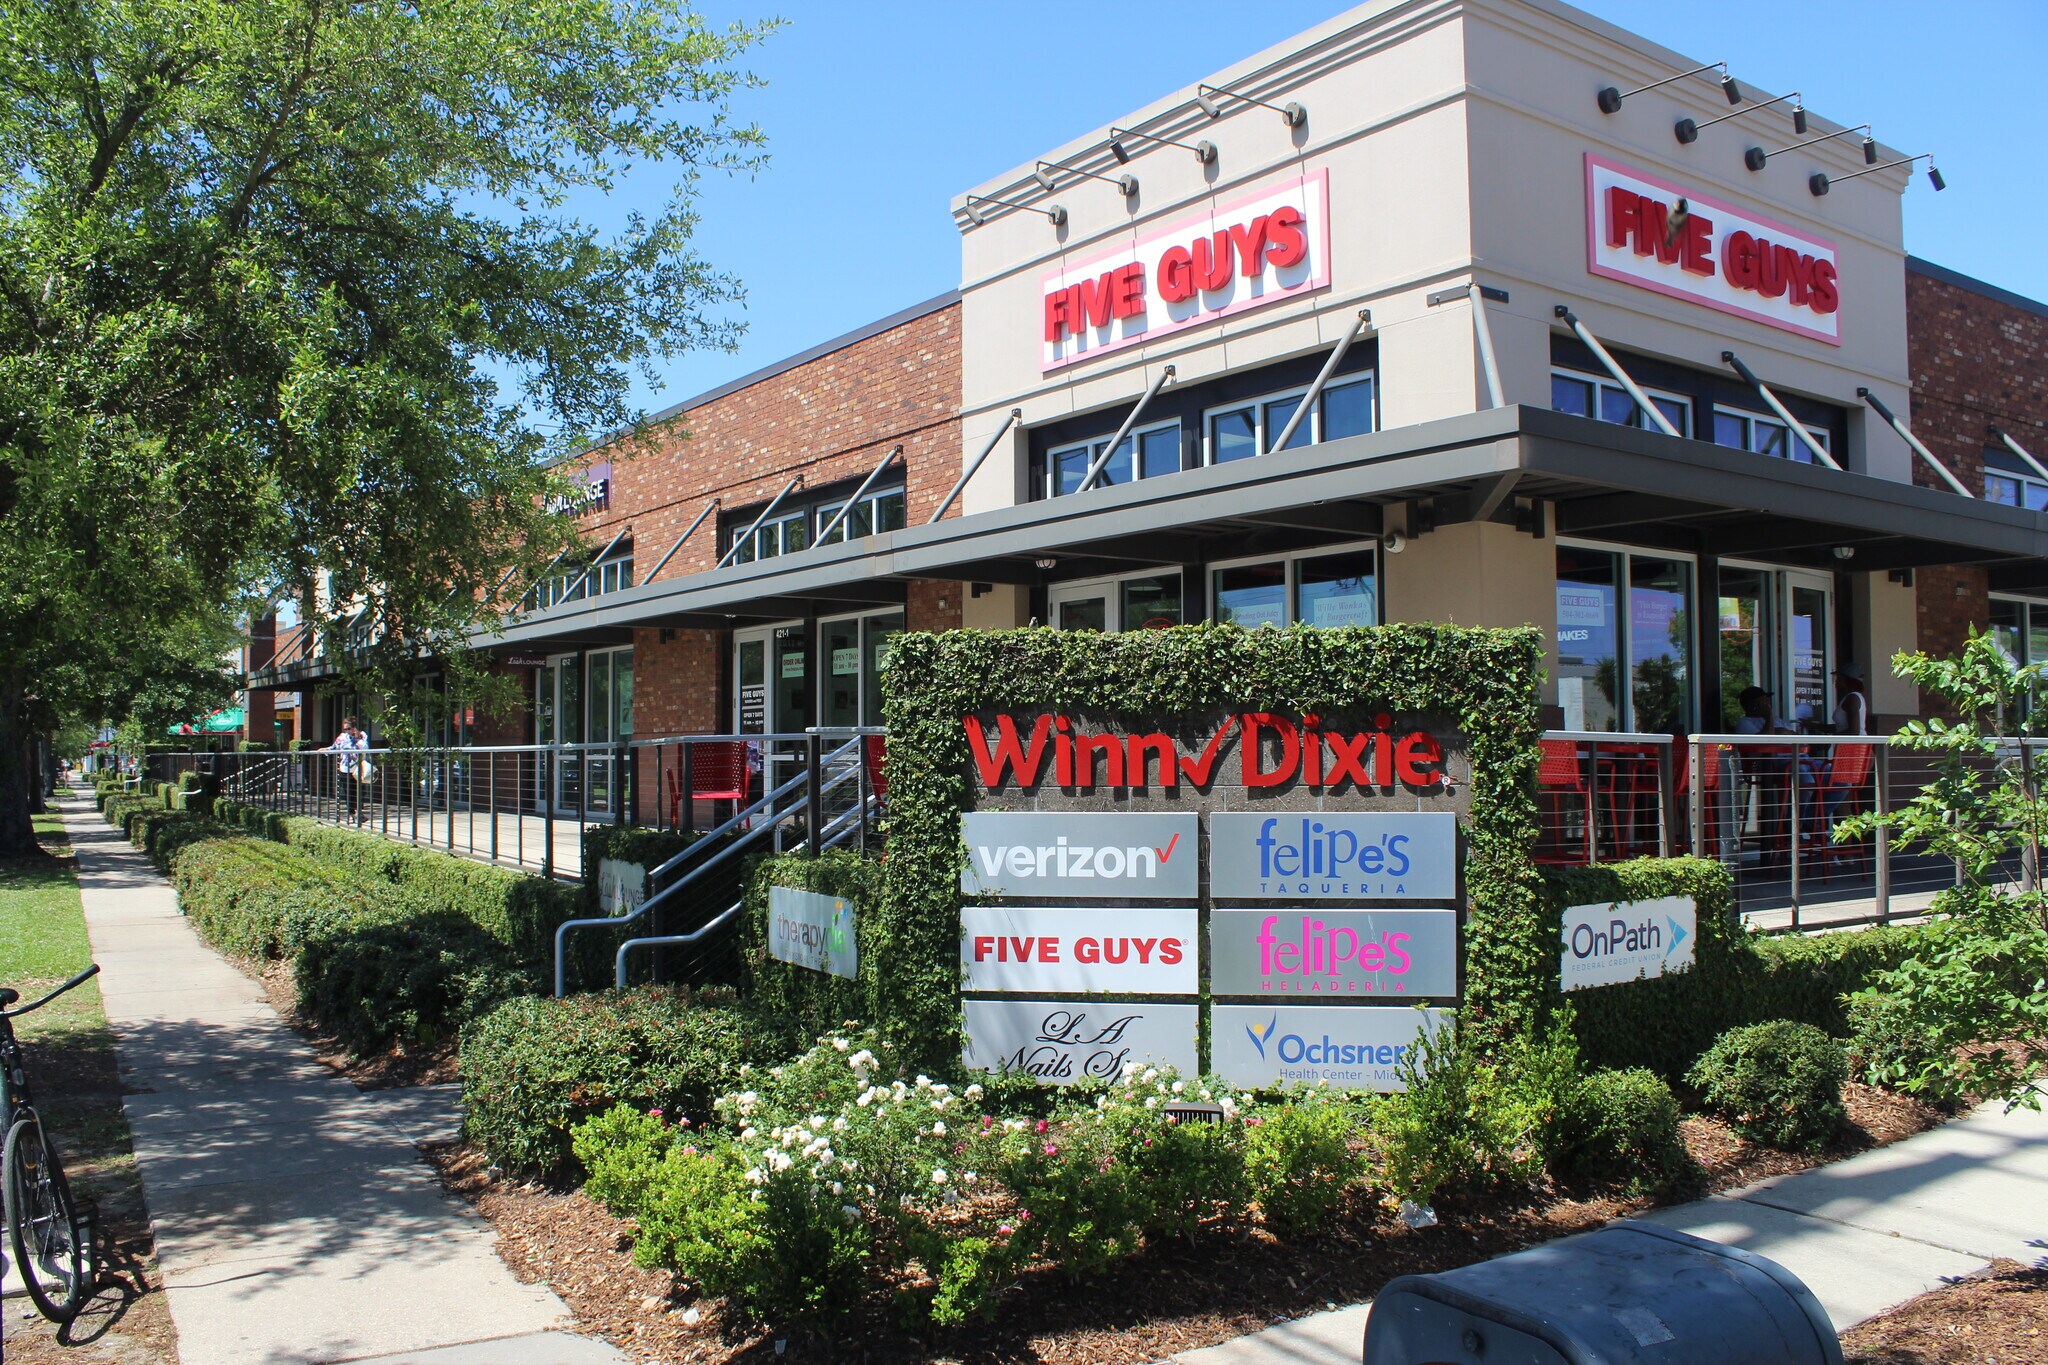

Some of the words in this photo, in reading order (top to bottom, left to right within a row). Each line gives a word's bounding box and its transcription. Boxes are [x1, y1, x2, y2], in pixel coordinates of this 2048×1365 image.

[1604, 186, 1715, 277] FIVE
[1721, 230, 1839, 315] GUYS
[1044, 261, 1147, 343] FIVE
[1157, 205, 1309, 303] GUYS
[1560, 596, 1577, 606] FIVE
[1579, 596, 1600, 607] GUYS
[776, 629, 789, 638] 421-1
[962, 713, 1176, 787] Winn
[1241, 712, 1442, 787] Dixie
[978, 836, 1156, 878] verizon
[1260, 883, 1406, 894] TAQUERIA
[974, 936, 1060, 963] FIVE
[1073, 936, 1184, 965] GUYS
[1571, 918, 1661, 960] OnPath
[1571, 962, 1606, 972] FEDERAL
[1608, 956, 1636, 967] CREDIT
[1638, 953, 1661, 963] UNION
[1261, 980, 1406, 992] HELADERIA
[984, 1046, 1073, 1078] Nails
[1277, 1034, 1406, 1065] Ochsner
[1279, 1068, 1319, 1080] Health
[1322, 1069, 1362, 1080] Center
